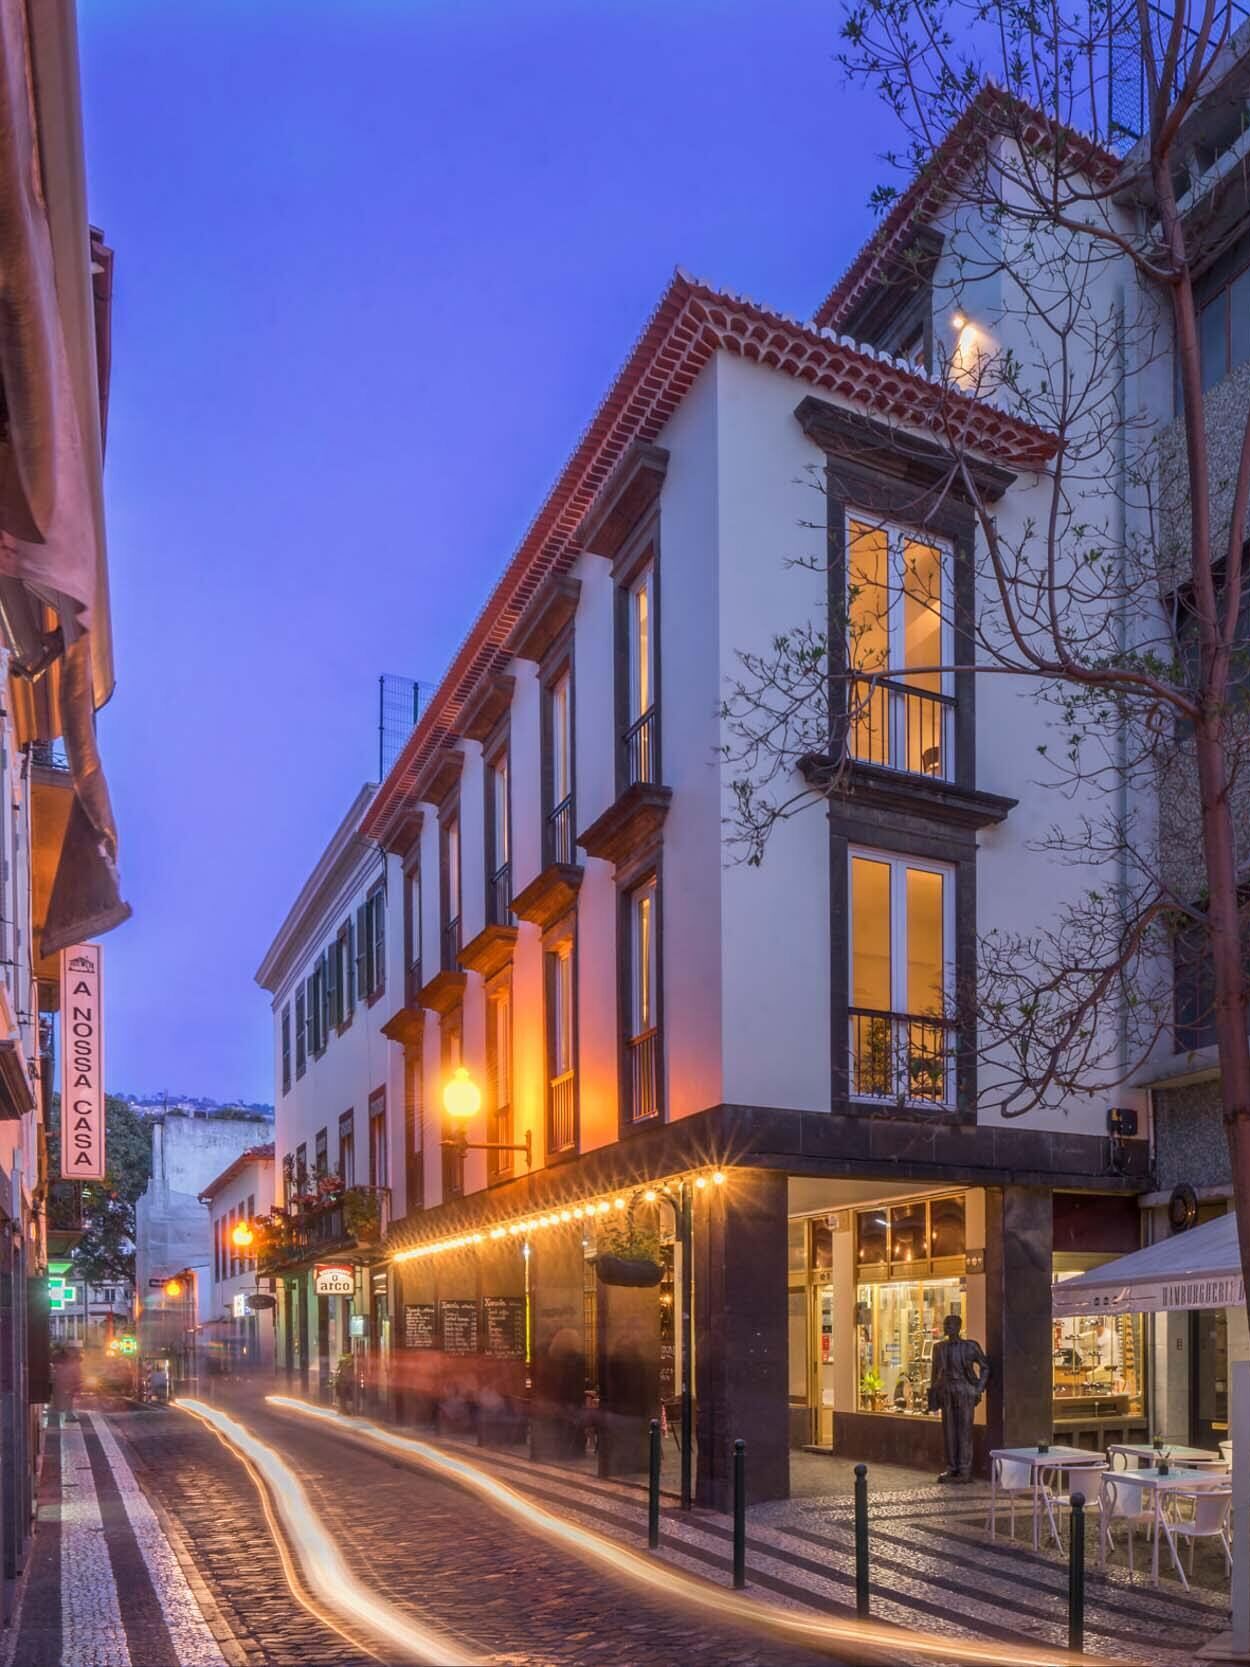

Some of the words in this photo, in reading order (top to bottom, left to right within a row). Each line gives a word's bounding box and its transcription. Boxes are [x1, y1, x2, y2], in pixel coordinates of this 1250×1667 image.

[72, 980, 92, 997] A
[72, 1006, 93, 1089] NOSSA
[73, 1100, 93, 1167] CASA
[320, 1282, 350, 1291] arco
